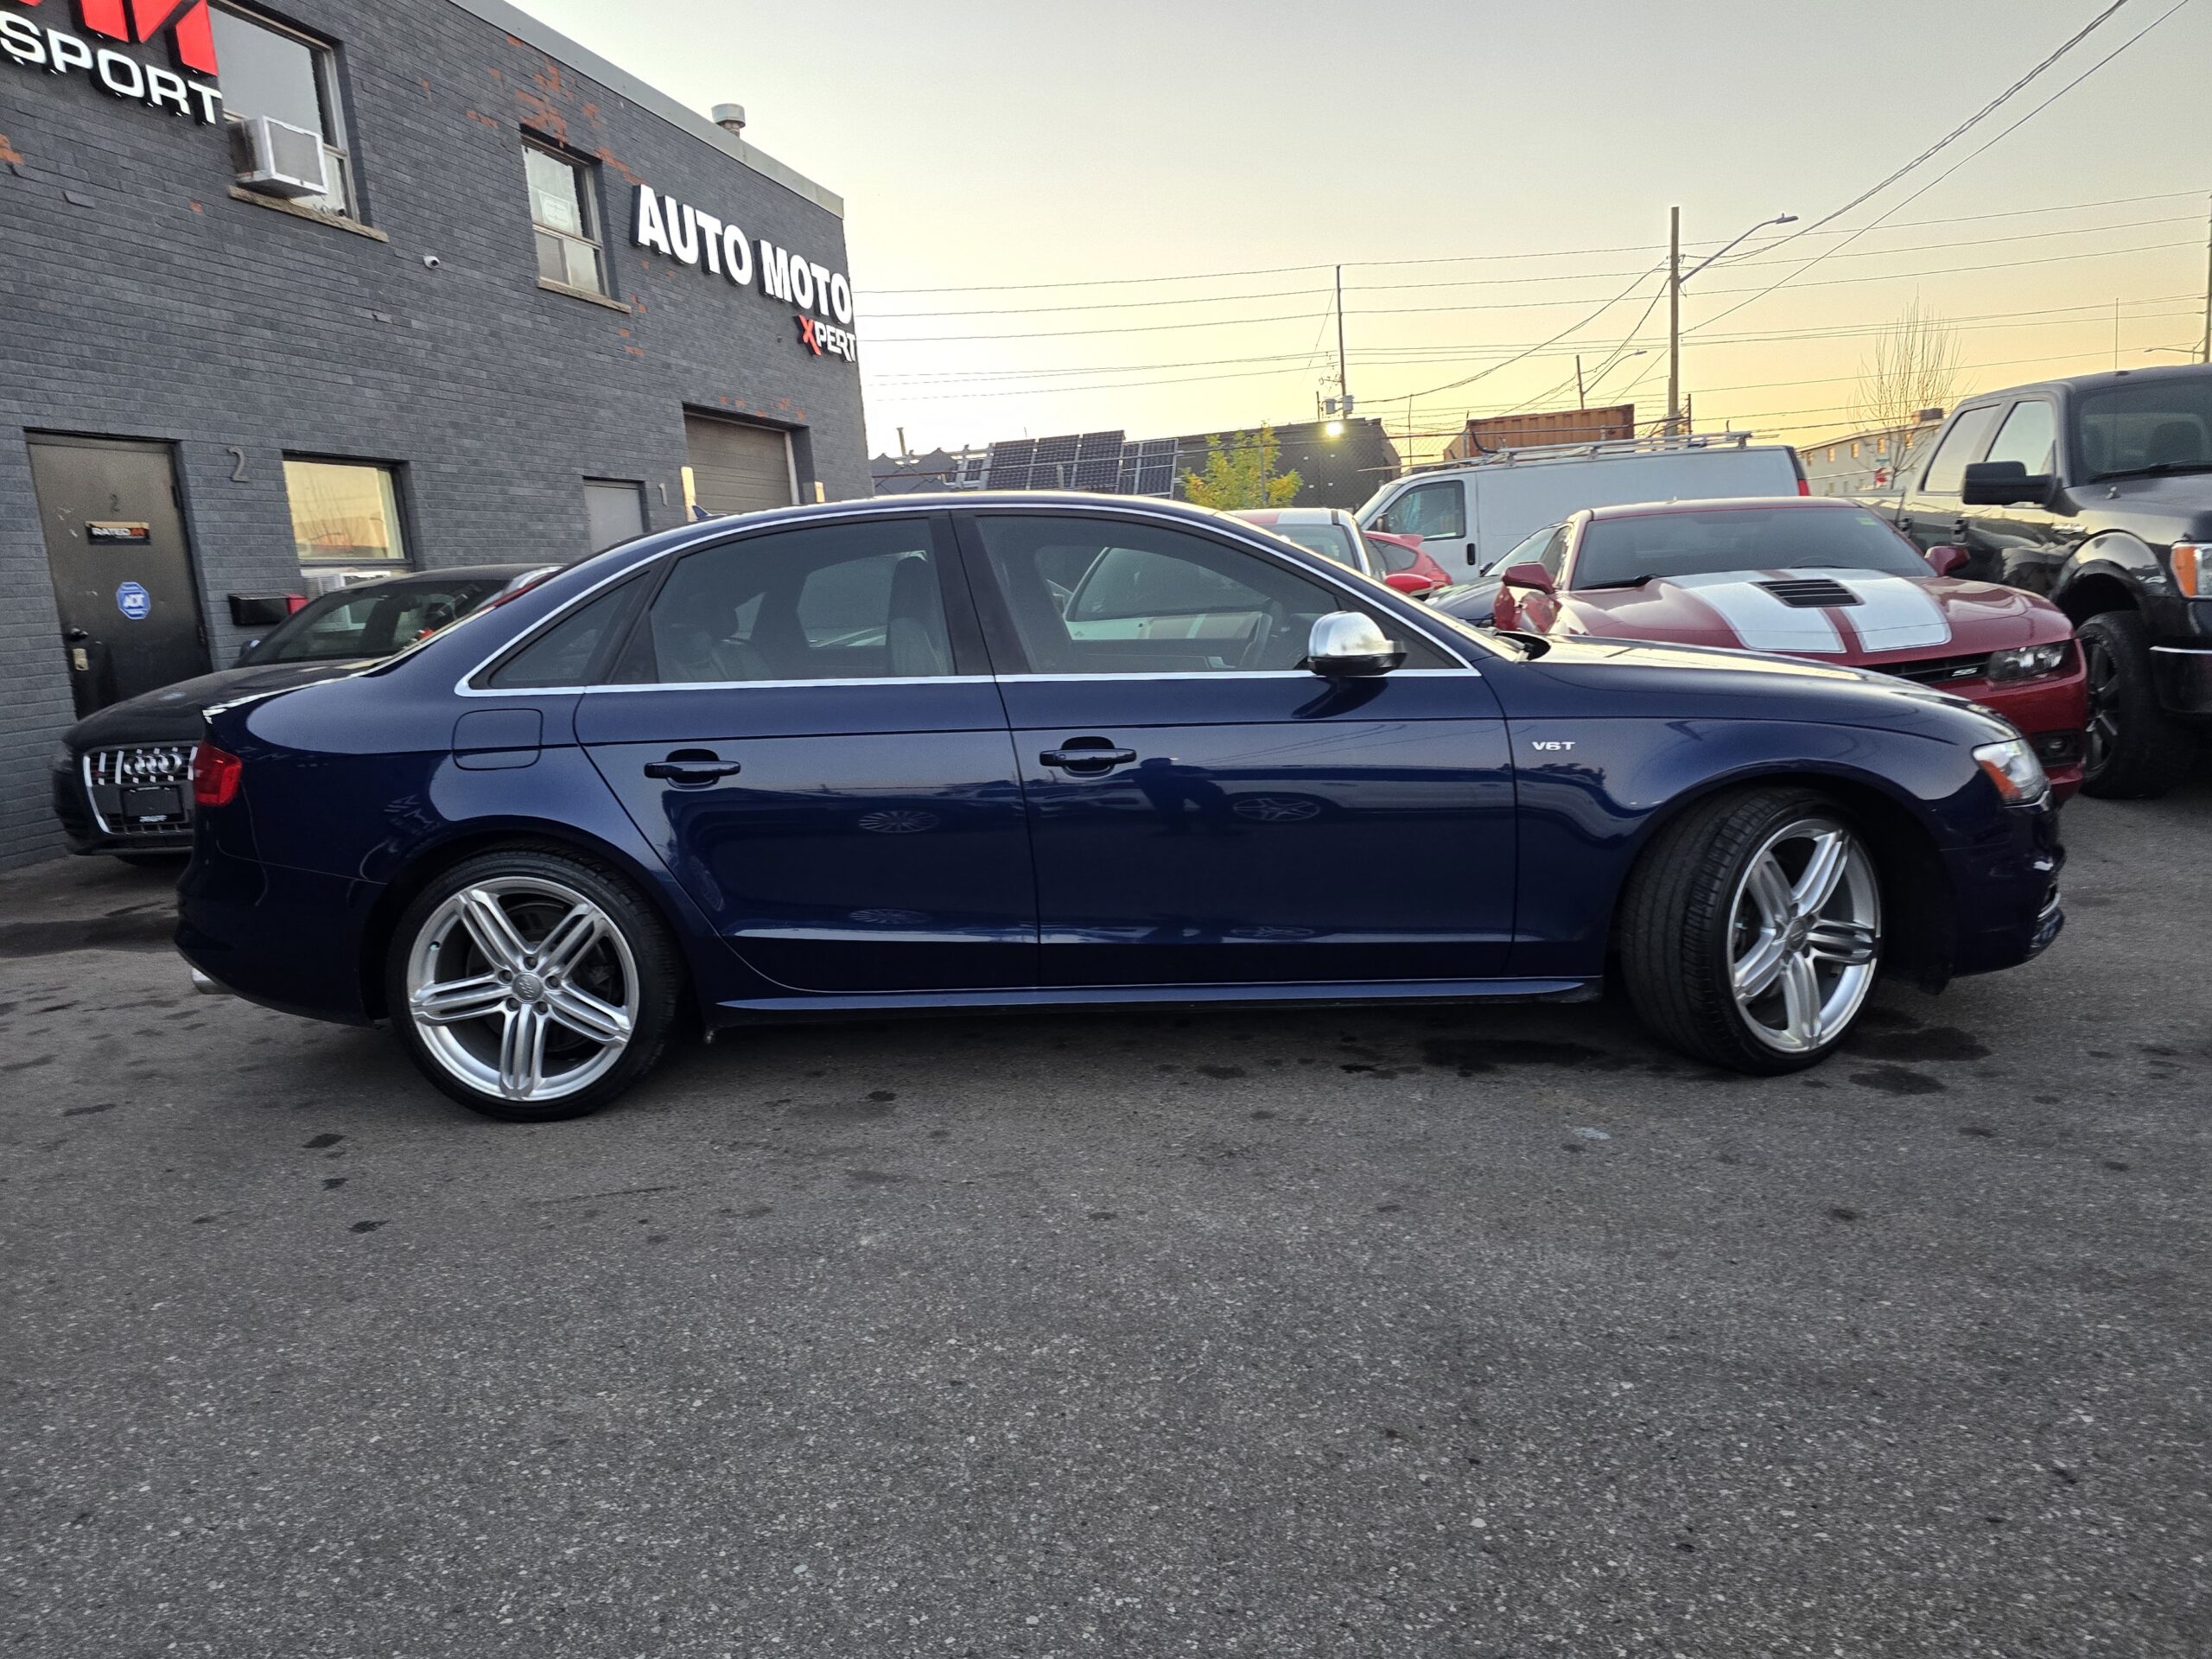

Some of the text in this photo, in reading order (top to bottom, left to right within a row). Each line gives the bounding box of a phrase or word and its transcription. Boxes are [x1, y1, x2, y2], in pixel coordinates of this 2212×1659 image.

[0, 10, 223, 124] SPORT
[638, 184, 853, 325] AUTO MOTO
[798, 315, 856, 363] XPERT
[226, 447, 250, 482] 2
[1532, 741, 1576, 751] V6T
